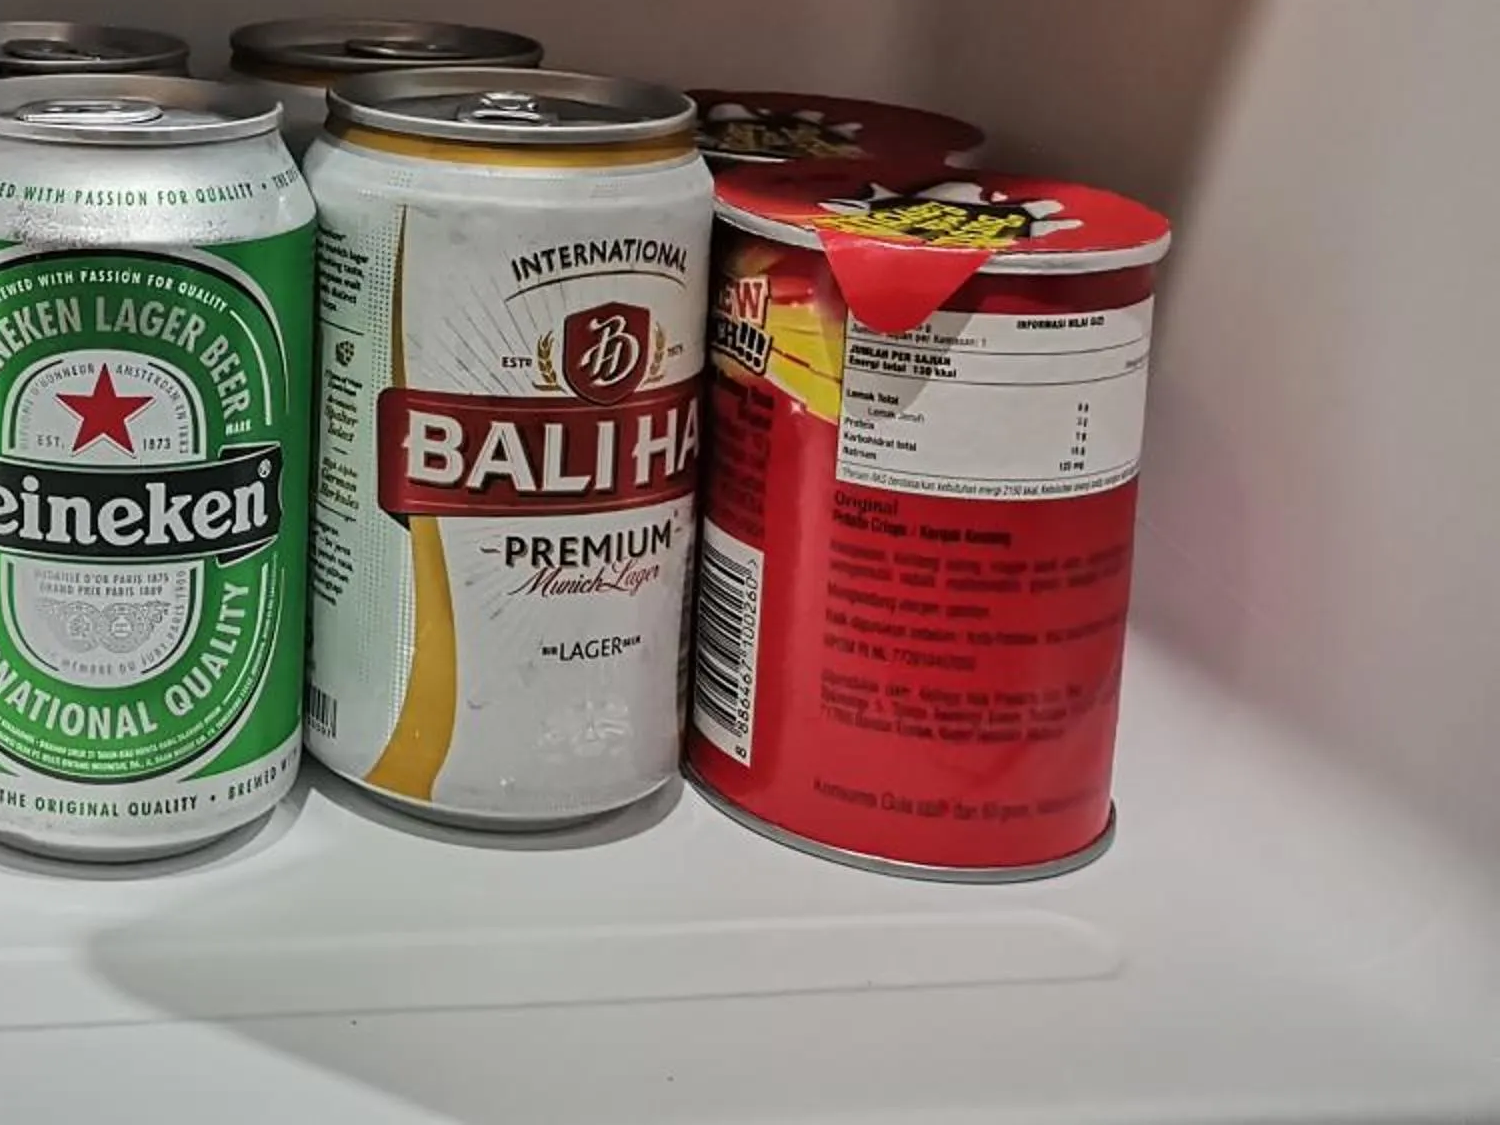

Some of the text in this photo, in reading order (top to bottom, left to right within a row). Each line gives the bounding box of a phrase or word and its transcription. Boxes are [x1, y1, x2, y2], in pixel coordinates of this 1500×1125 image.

[23, 186, 65, 203] WITH
[74, 190, 147, 206] PASSION
[157, 190, 189, 206] FOR
[195, 183, 253, 203] QUALITY
[510, 238, 687, 281] INTERNATIONAL
[38, 271, 73, 287] WITH
[81, 270, 141, 284] PASSION
[148, 275, 172, 290] FOR
[178, 282, 228, 312] QUALITY
[95, 296, 206, 354] LAGER
[200, 335, 251, 419] BEER
[849, 355, 879, 369] Energi
[935, 368, 957, 378] kkal
[892, 350, 911, 362] PER
[846, 388, 875, 402] Lemak
[143, 438, 171, 451] 1873
[402, 409, 614, 492] BALI
[896, 440, 917, 452] total
[834, 488, 899, 519] Original
[504, 519, 672, 567] PREMIUM
[508, 558, 660, 597] Munich Lager
[165, 583, 251, 717] QUALITY
[560, 636, 622, 661] LAGER
[735, 746, 748, 759] 8
[742, 577, 758, 647] 100260
[0, 788, 26, 808] THE
[35, 797, 118, 817] ORIGINAL
[128, 795, 197, 816] QUALITY
[228, 766, 277, 800] BREWED
